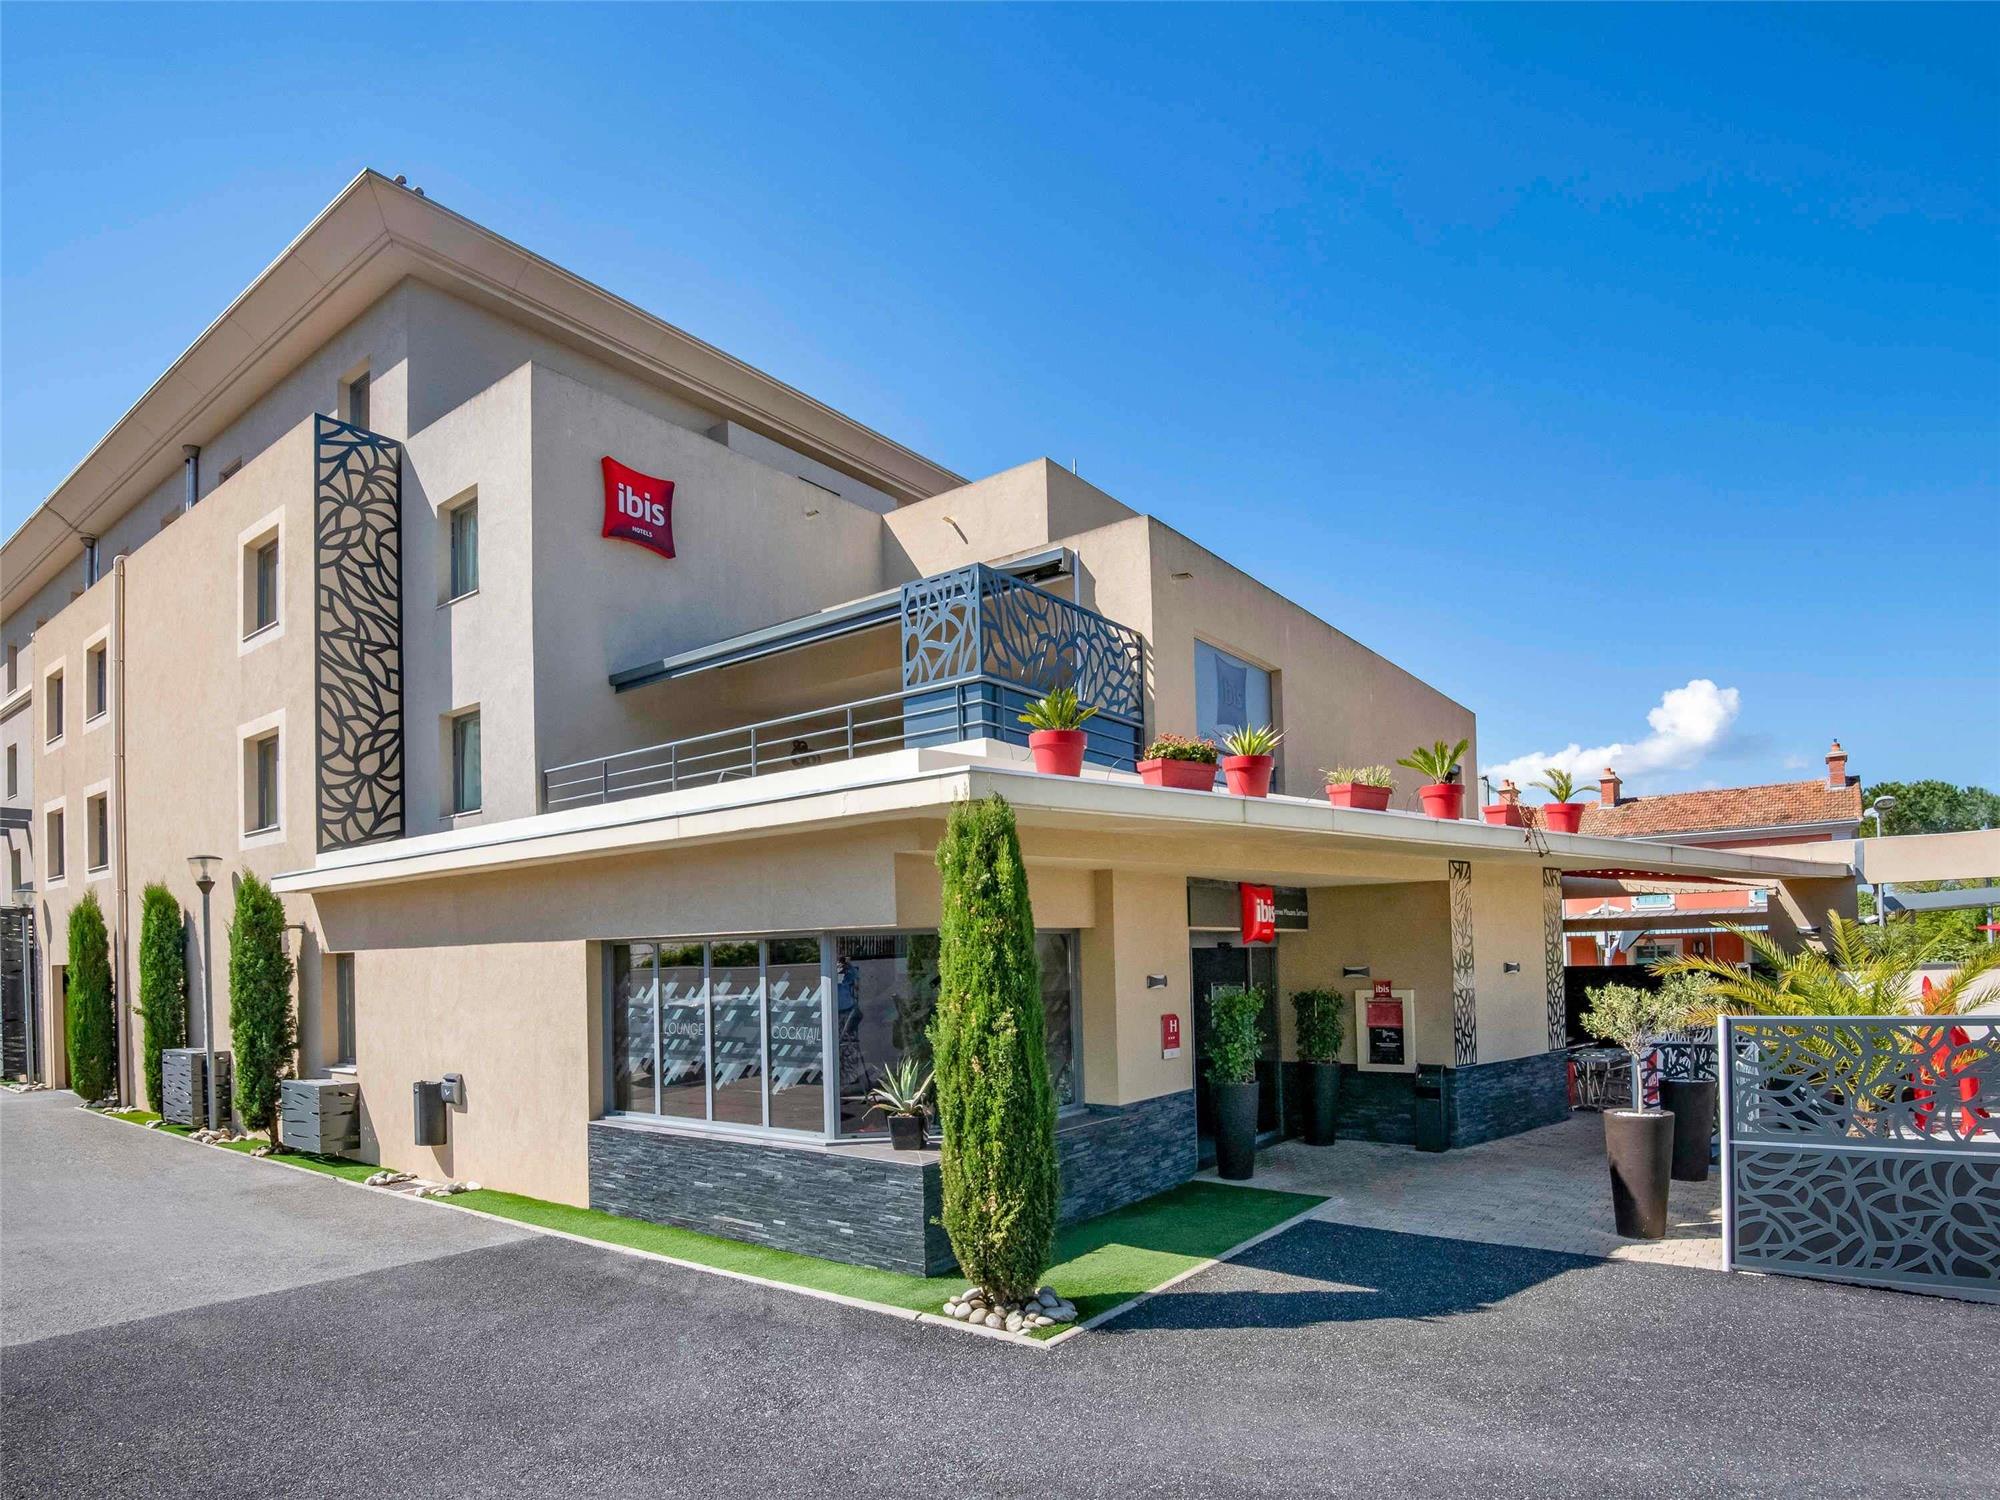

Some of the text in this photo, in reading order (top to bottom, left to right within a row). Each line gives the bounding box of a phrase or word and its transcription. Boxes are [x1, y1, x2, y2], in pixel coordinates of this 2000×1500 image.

[618, 482, 665, 526] ibis
[631, 526, 653, 538] HOTELS
[1256, 898, 1275, 923] ibis
[1375, 984, 1390, 993] ibis
[664, 1023, 704, 1036] LOUNGE
[771, 1025, 821, 1041] COCKTAIL
[1169, 1019, 1177, 1033] H
